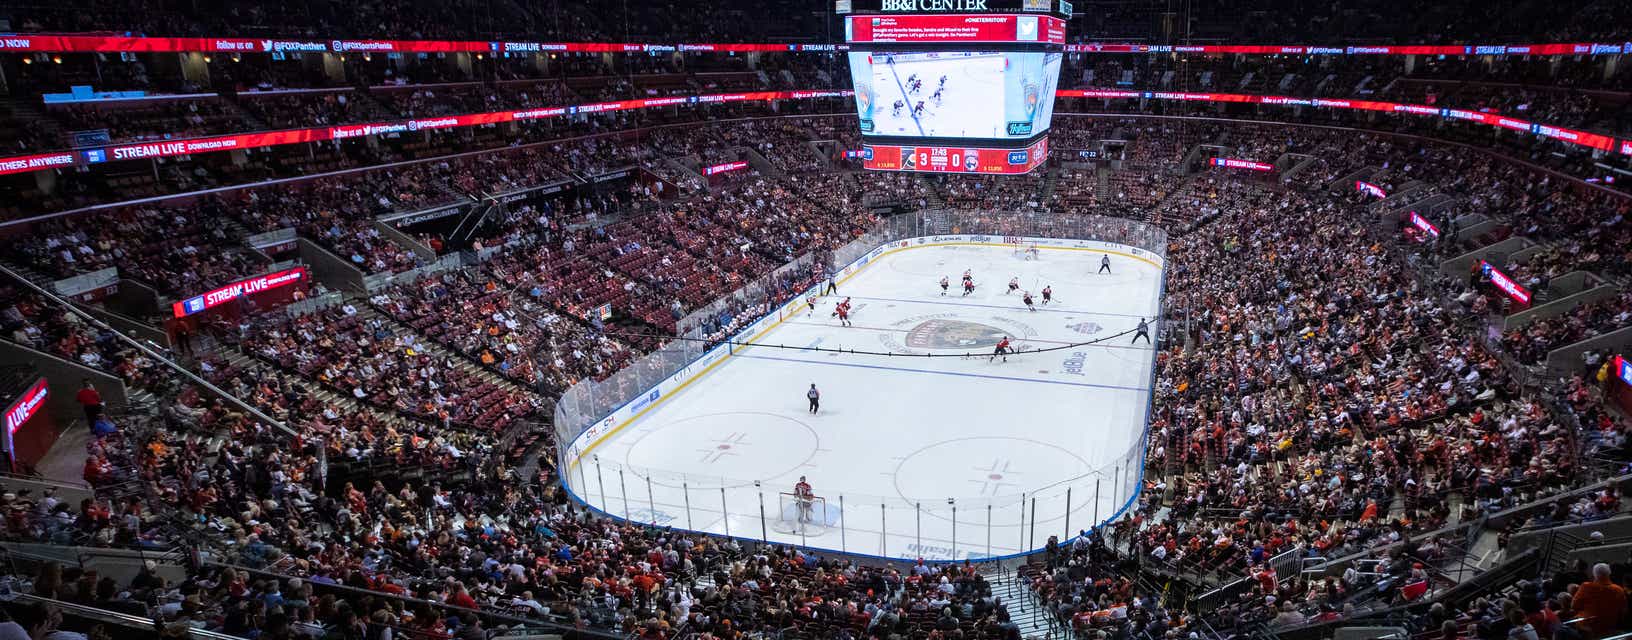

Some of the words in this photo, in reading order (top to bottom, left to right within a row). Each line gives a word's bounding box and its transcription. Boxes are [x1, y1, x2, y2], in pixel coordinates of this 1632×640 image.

[920, 0, 988, 10] CENTER
[6, 38, 30, 48] NOW
[216, 40, 235, 50] follow
[274, 41, 326, 50] @FOXPanthers
[114, 145, 160, 158] STREAM
[161, 143, 185, 154] LIVE
[188, 141, 221, 150] DOWNLOAD
[29, 155, 72, 168] ANYWHERE
[920, 153, 928, 166] 3
[953, 154, 960, 167] 0
[208, 285, 242, 304] STREAM
[245, 278, 268, 293] LIVE
[12, 402, 29, 426] LIVE
